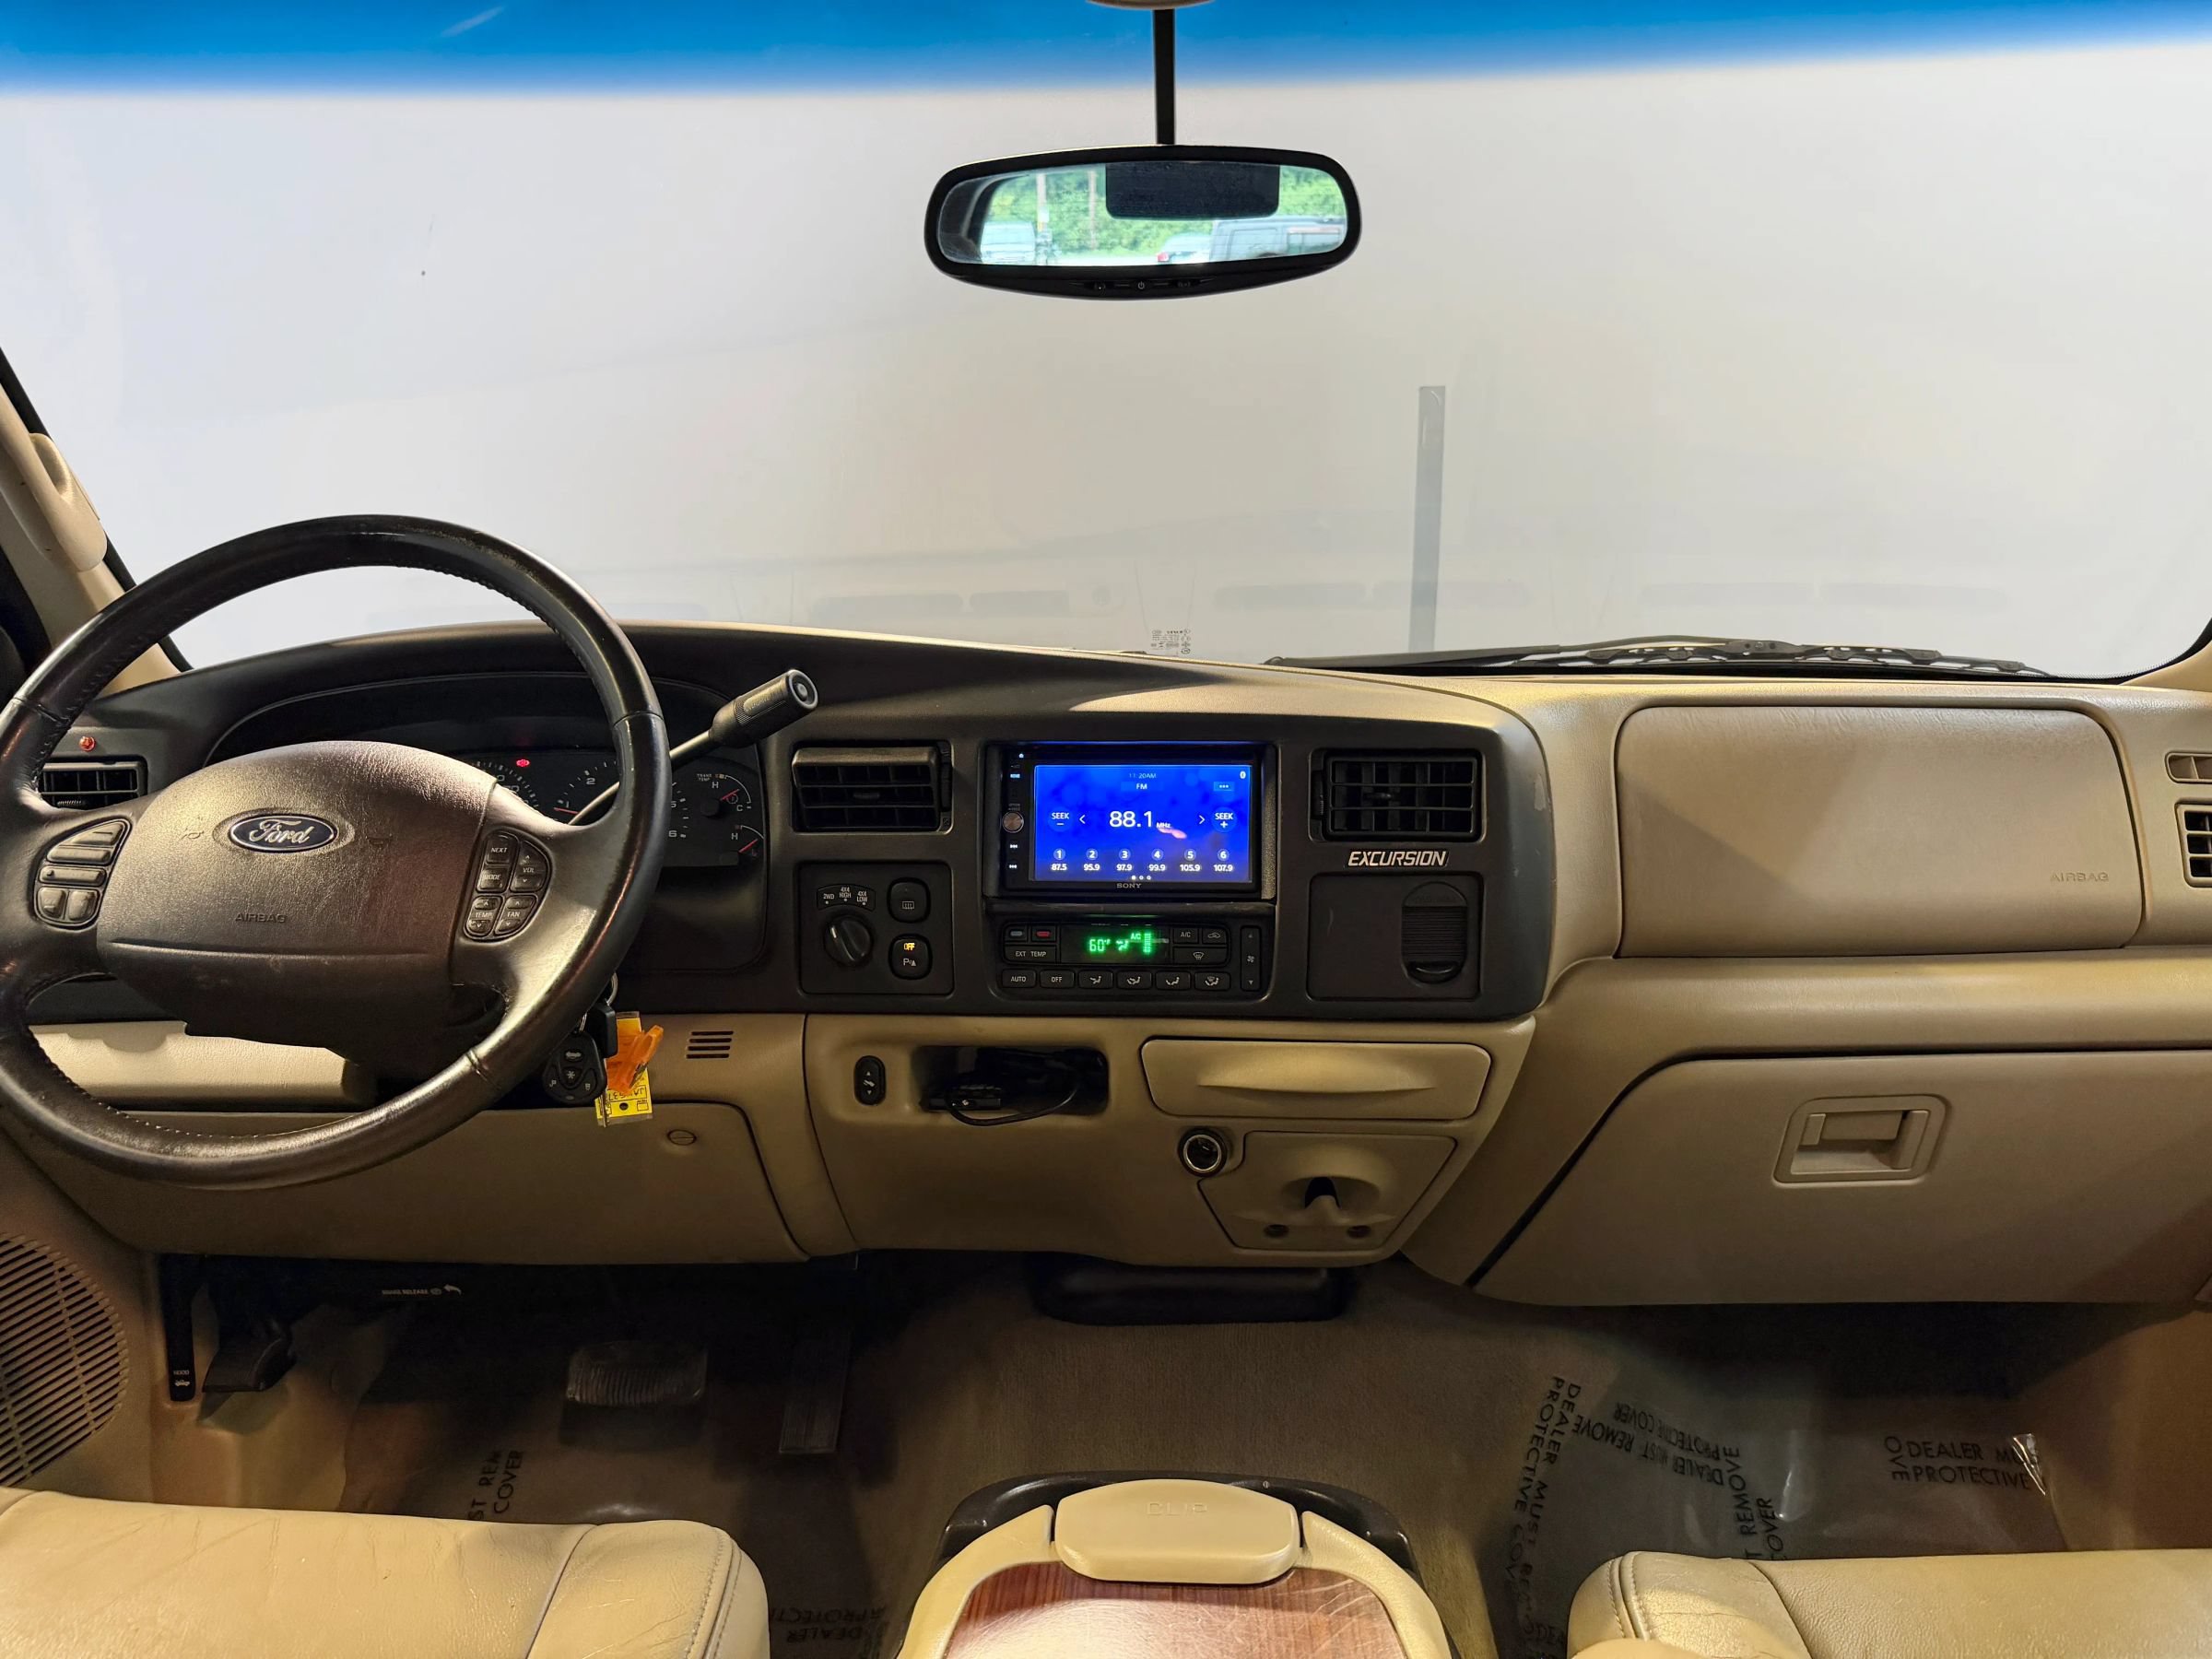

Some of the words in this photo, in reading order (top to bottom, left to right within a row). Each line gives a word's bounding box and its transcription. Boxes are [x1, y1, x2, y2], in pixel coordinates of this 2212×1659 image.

[586, 777, 596, 785] 2
[712, 781, 719, 789] H
[1109, 810, 1153, 828] 88.1
[1215, 812, 1233, 820] SEEK
[249, 818, 314, 844] Ford
[668, 830, 677, 838] 6
[731, 832, 738, 841] H
[1347, 851, 1446, 866] EXCURSION
[2050, 871, 2110, 882] AIRBAG
[235, 912, 288, 924] AIRBAG
[903, 942, 915, 950] OFF
[1542, 1382, 1581, 1465] DEALER
[1572, 1415, 1635, 1453] REMOVE
[1514, 1376, 1565, 1512] PROTECTIVE
[1907, 1441, 1983, 1460] DEALER
[494, 1451, 524, 1513] COVER
[1912, 1465, 2030, 1489] PROTECTIVE
[1724, 1446, 1758, 1535] REMOVE
[468, 1499, 487, 1520] ST
